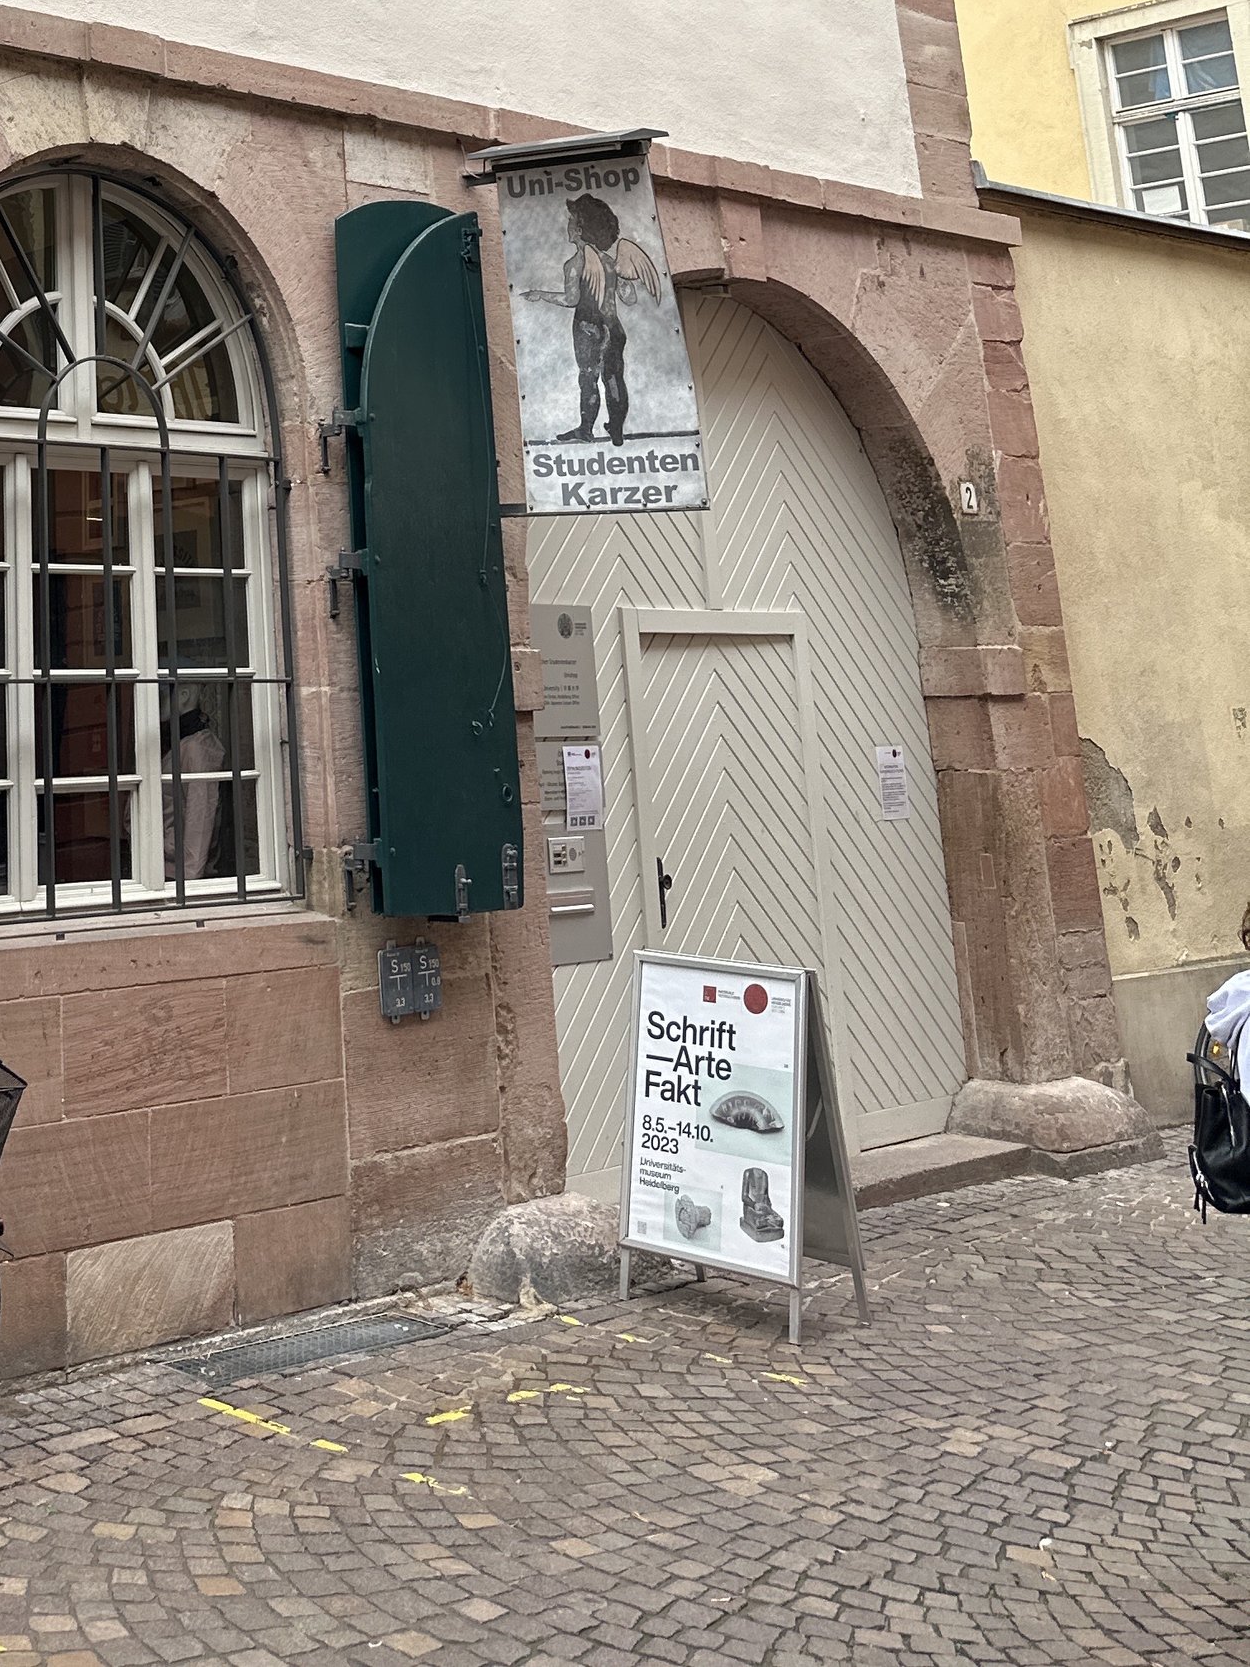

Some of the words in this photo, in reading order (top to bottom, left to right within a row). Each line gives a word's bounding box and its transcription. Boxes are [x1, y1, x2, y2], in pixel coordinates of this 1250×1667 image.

[506, 166, 641, 199] Uni-Shop
[532, 448, 700, 478] Studenten
[561, 481, 679, 506] Karzer
[965, 486, 974, 510] 2
[391, 959, 399, 974] S
[419, 955, 427, 970] S
[646, 1010, 737, 1052] Schrift
[644, 1069, 702, 1107] Fakt
[641, 1132, 679, 1155] 2023
[639, 1168, 672, 1181] museum
[639, 1176, 680, 1195] Heidelberg
